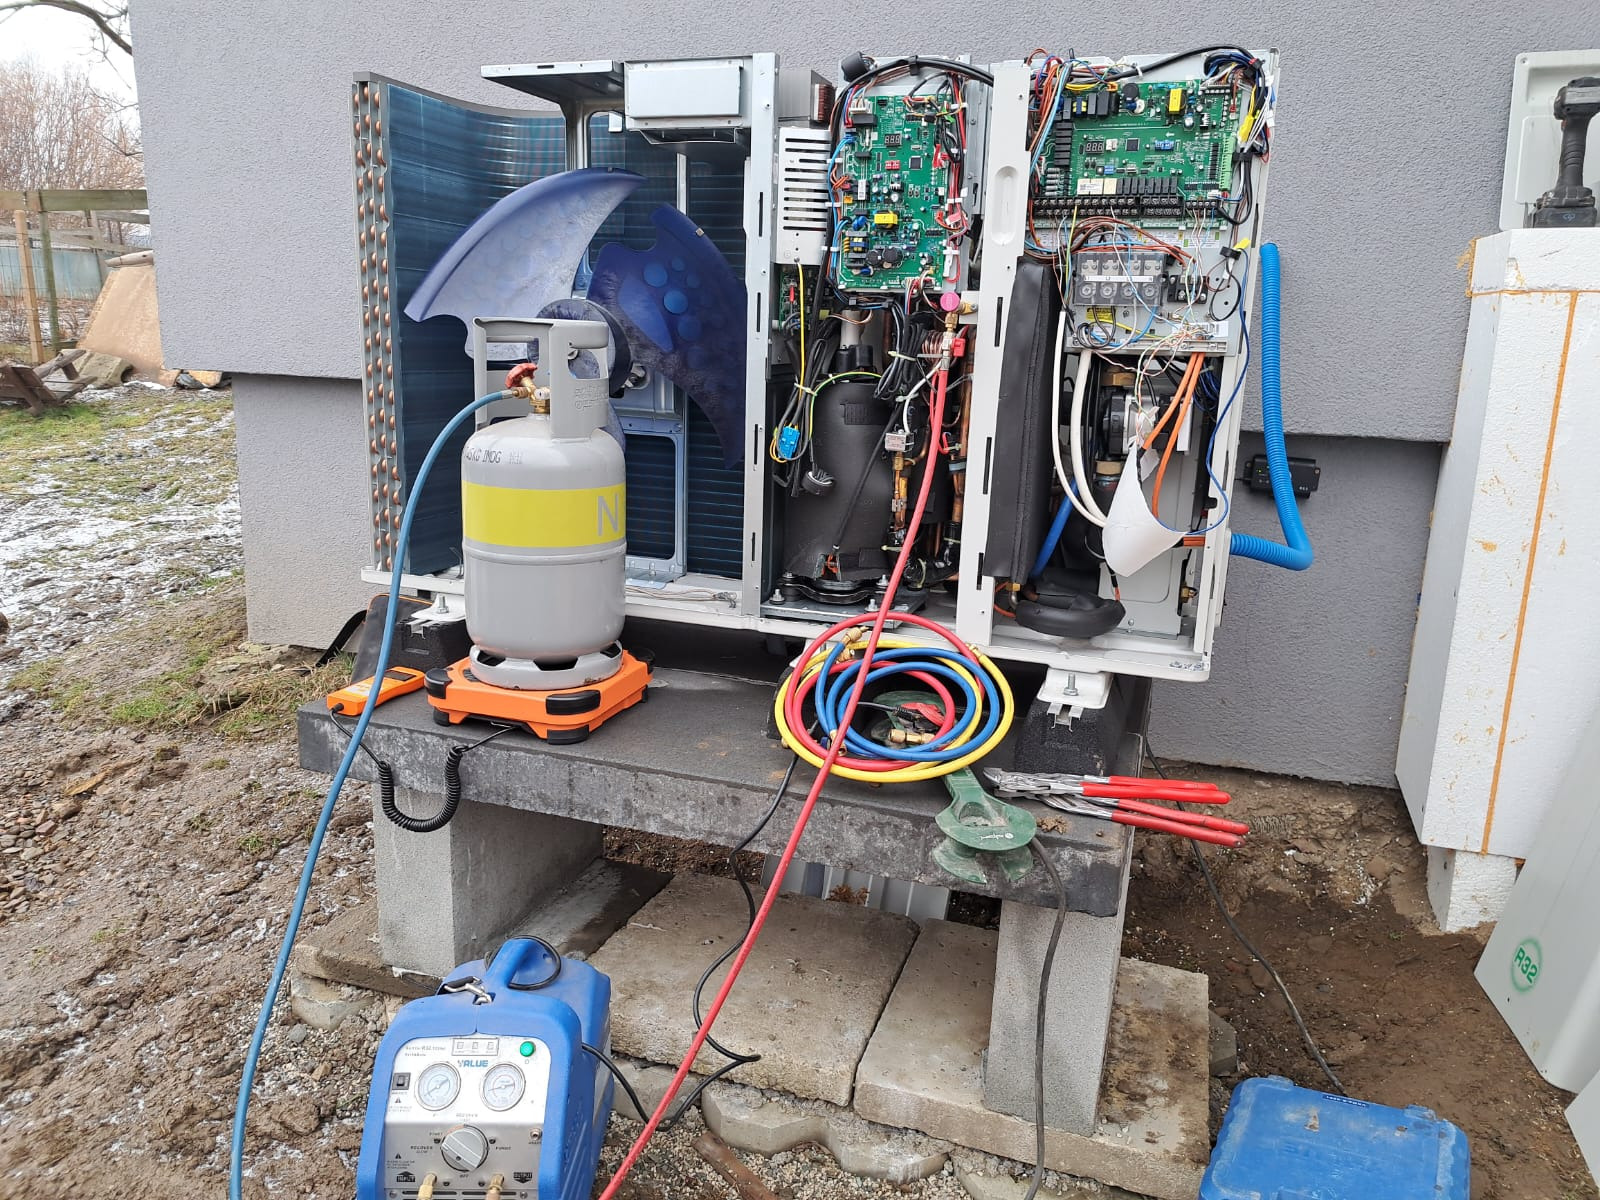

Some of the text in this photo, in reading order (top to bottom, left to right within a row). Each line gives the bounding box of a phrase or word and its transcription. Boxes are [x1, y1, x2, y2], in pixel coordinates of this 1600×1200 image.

[597, 493, 619, 536] N
[1513, 947, 1538, 984] R32
[457, 1060, 489, 1068] VALUE
